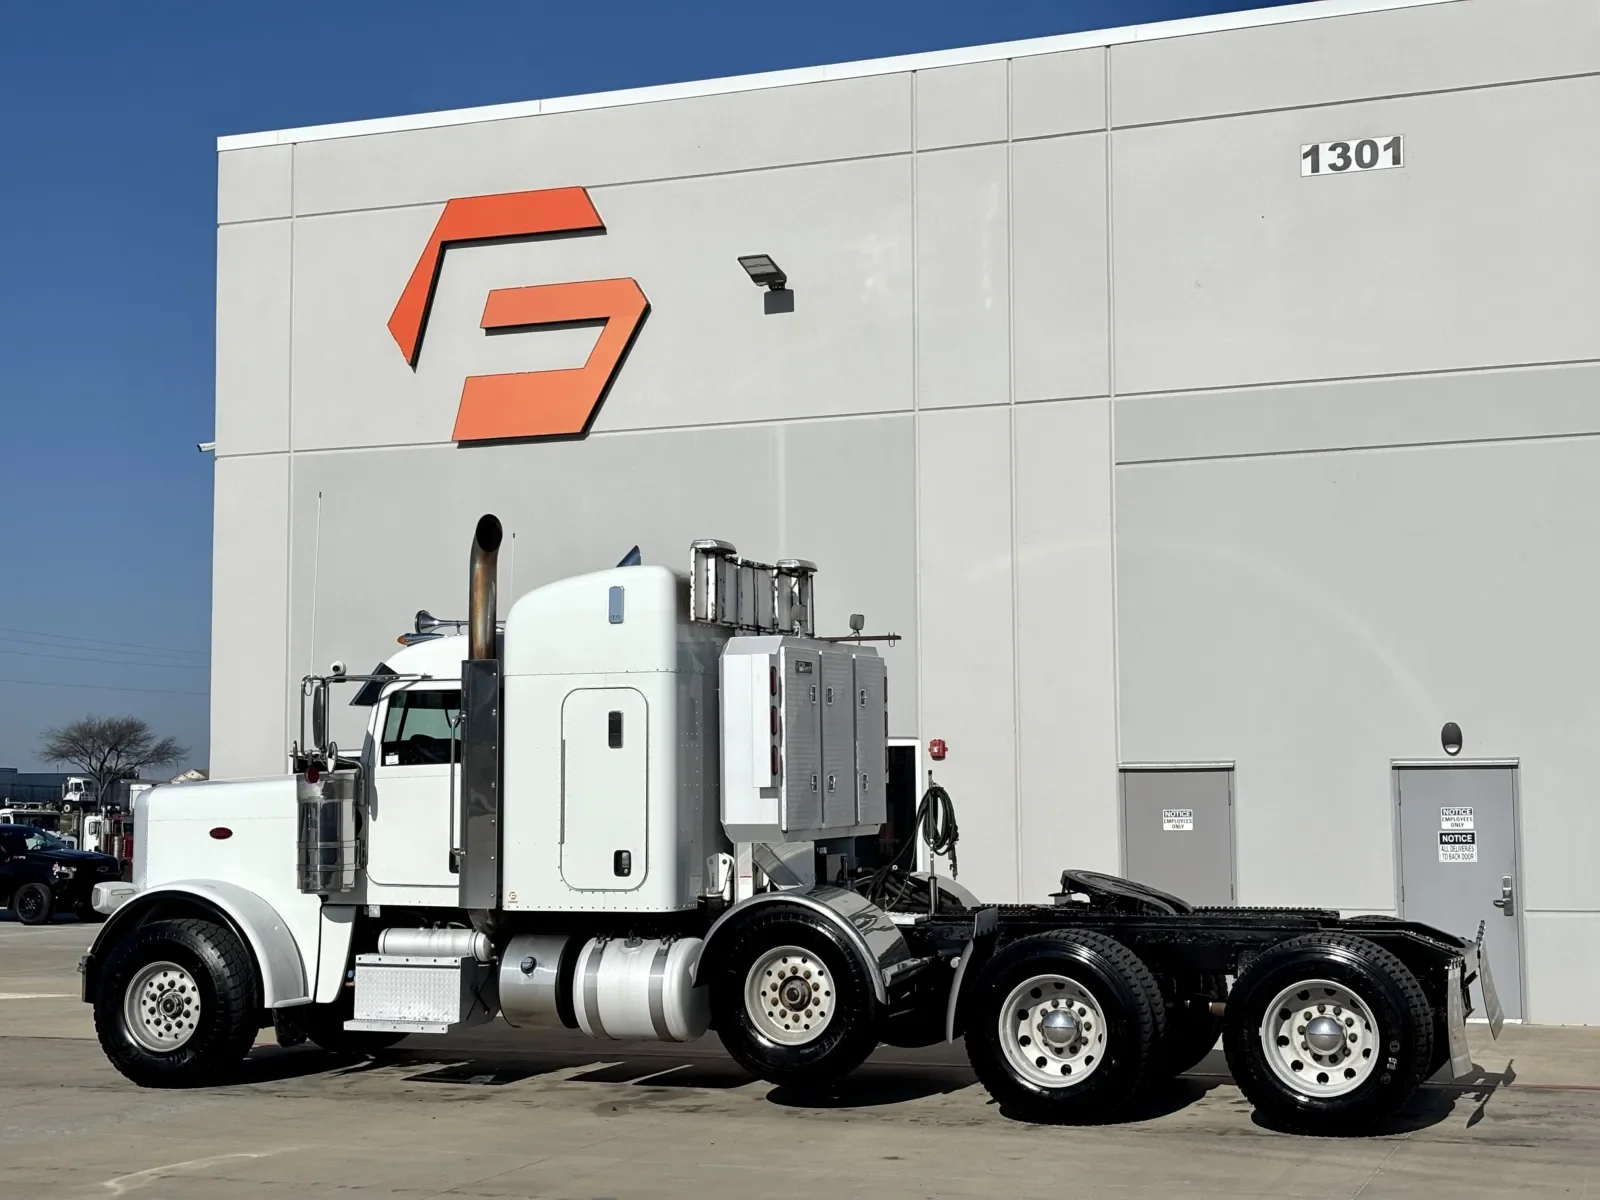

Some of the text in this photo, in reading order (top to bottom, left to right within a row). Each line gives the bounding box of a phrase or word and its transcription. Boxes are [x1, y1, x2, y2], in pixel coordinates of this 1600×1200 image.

[1302, 136, 1401, 174] 1301
[1442, 808, 1472, 816] NOTICE
[1442, 834, 1473, 843] NOTICE
